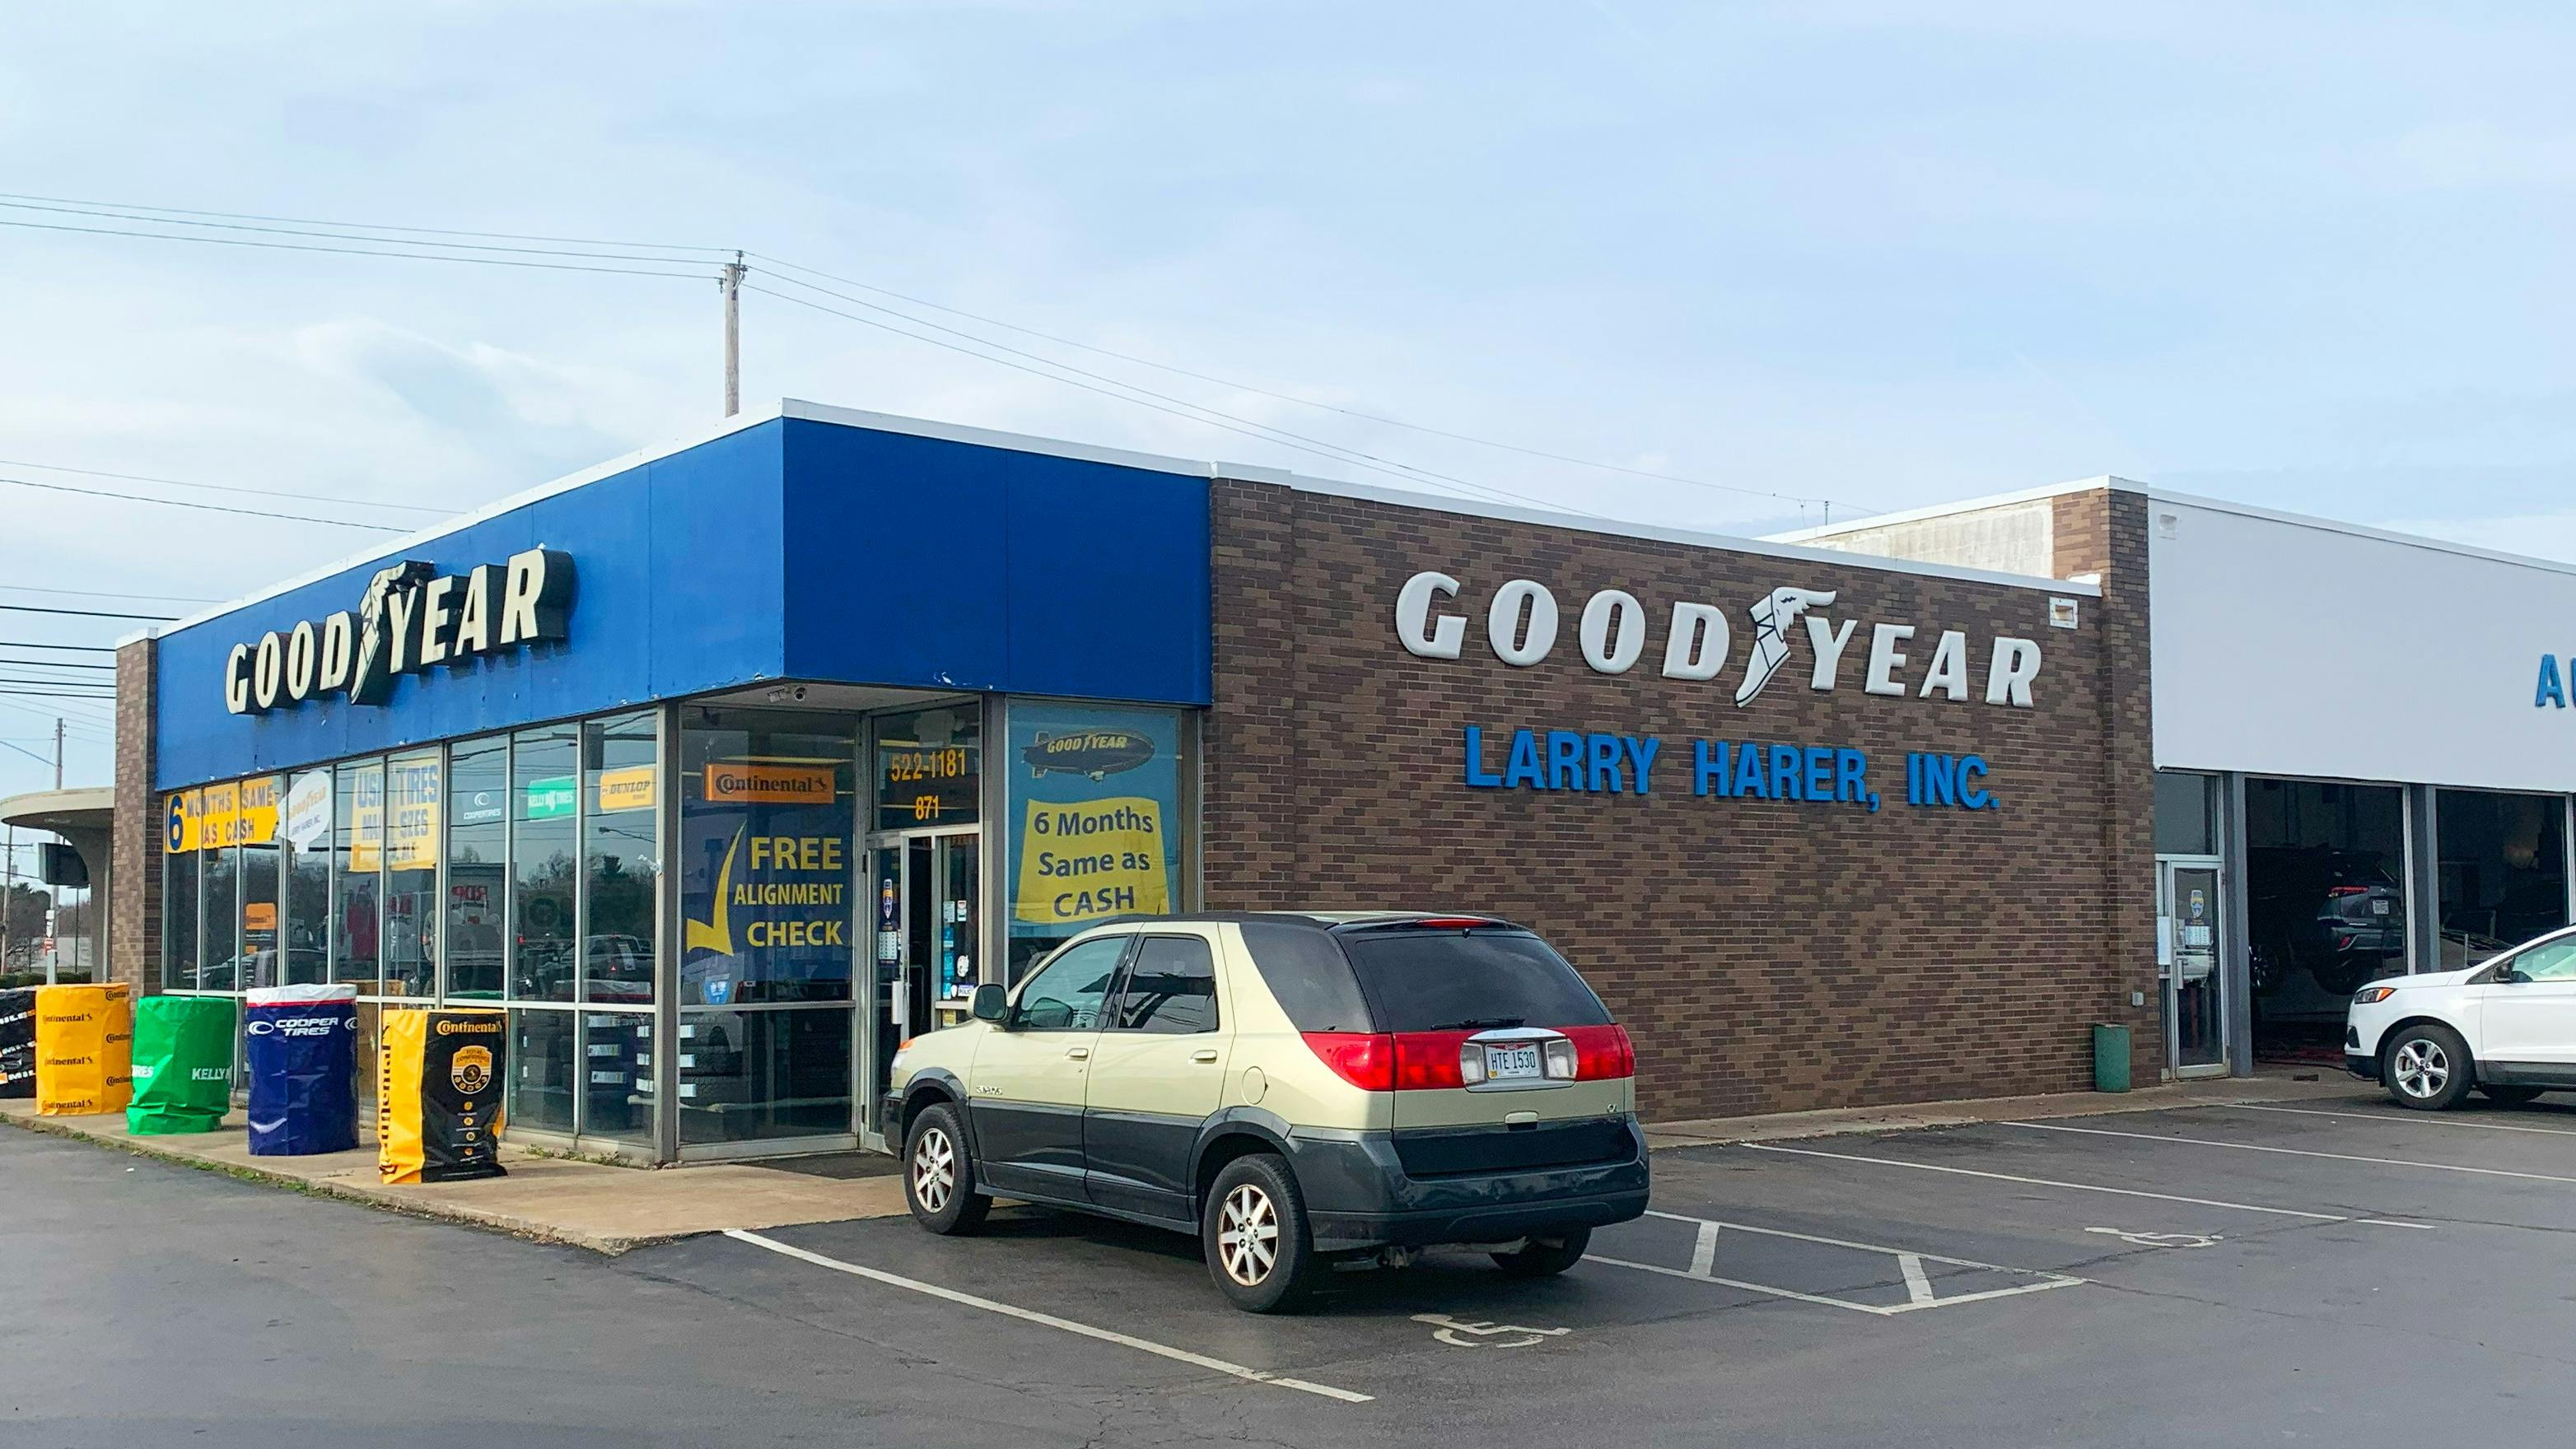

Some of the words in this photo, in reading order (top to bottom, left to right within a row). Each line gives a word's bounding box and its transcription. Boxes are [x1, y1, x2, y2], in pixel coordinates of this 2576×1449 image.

[2535, 653, 2576, 708] A
[890, 748, 967, 782] 522-1181
[1463, 724, 1660, 795] LARRY
[1694, 739, 1881, 813] HARER,
[1907, 752, 2000, 809] INC.
[609, 780, 651, 795] DUNLOP
[716, 772, 814, 795] Continental
[168, 794, 184, 851] 6
[186, 790, 232, 818] MONTHS
[241, 784, 273, 809] SAME
[915, 794, 940, 821] 871
[1034, 812, 1050, 835] 6
[1057, 806, 1154, 836] Months
[203, 822, 217, 845] AS
[226, 817, 255, 841] CASH
[750, 837, 843, 871] FREE
[1038, 851, 1114, 878] Same
[1122, 853, 1151, 872] as
[734, 883, 843, 906] ALIGNMENT
[1053, 886, 1136, 917] CASH
[747, 920, 843, 948] CHECK
[43, 1013, 85, 1024] ontinental
[274, 1017, 339, 1027] COOPER
[283, 1026, 331, 1037] TIRES
[45, 1056, 86, 1067] ontinental
[131, 1065, 155, 1079] IRES
[192, 1067, 226, 1080] KELLY
[1491, 1052, 1510, 1069] HTE
[1512, 1051, 1536, 1069] 1530
